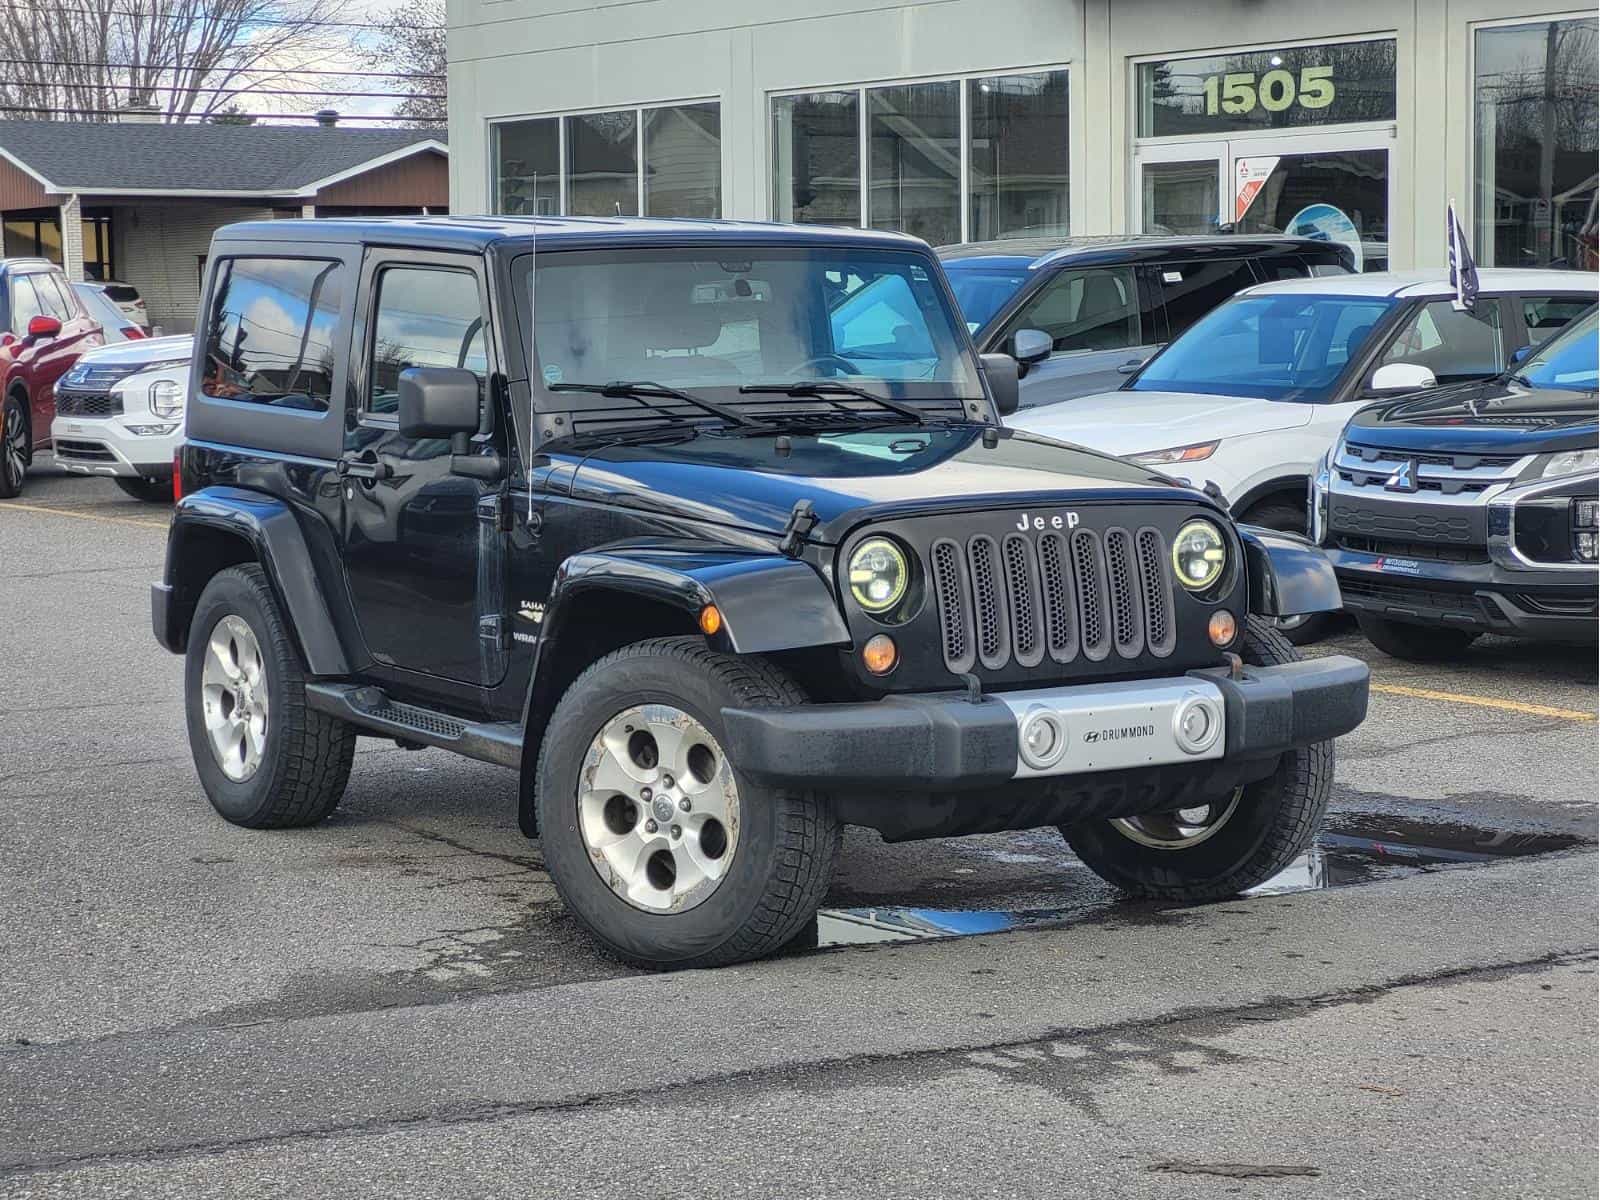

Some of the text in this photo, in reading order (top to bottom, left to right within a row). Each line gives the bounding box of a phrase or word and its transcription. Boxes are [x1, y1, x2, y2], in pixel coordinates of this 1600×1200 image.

[1203, 66, 1336, 116] 1505
[1016, 511, 1080, 532] Jeep
[520, 600, 546, 610] SAHA
[1102, 725, 1154, 741] DRUMMOND
